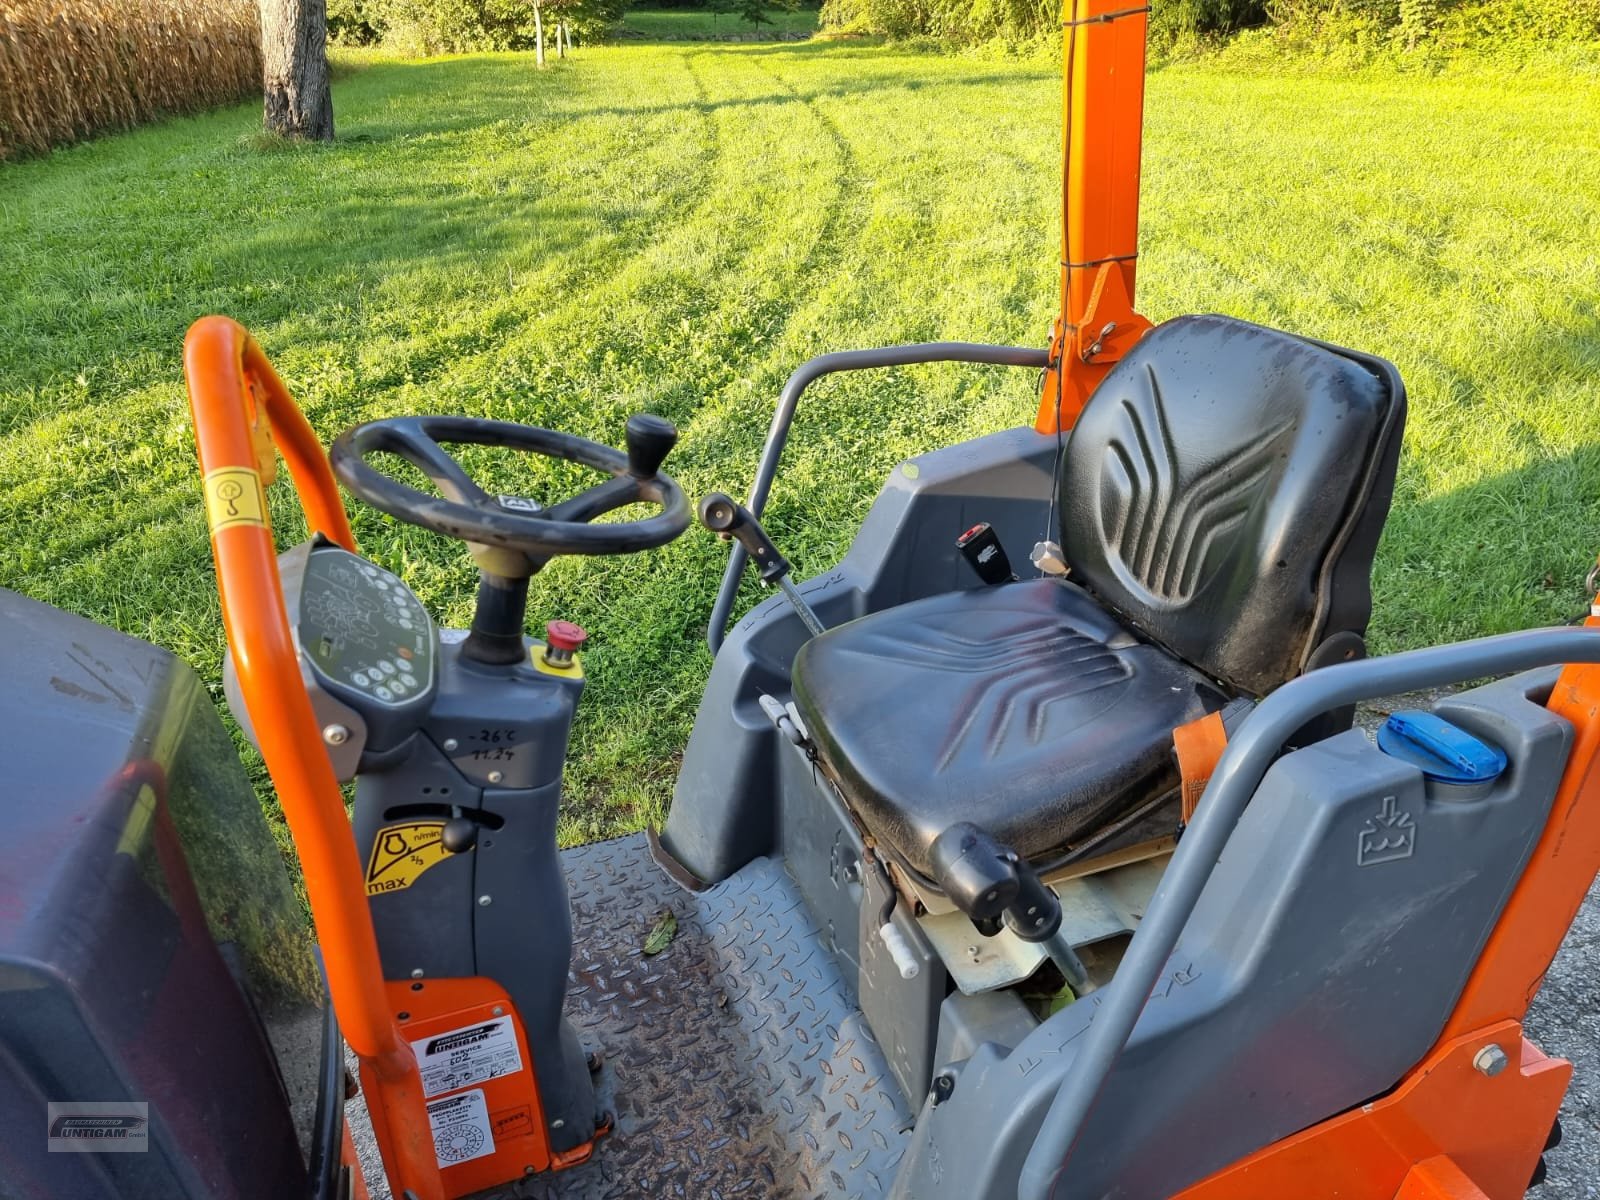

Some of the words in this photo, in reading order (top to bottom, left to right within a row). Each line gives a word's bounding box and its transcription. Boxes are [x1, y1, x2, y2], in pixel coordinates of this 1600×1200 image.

[368, 877, 407, 894] max
[435, 1033, 489, 1054] UNTIGAM
[450, 1044, 482, 1057] SERVICE
